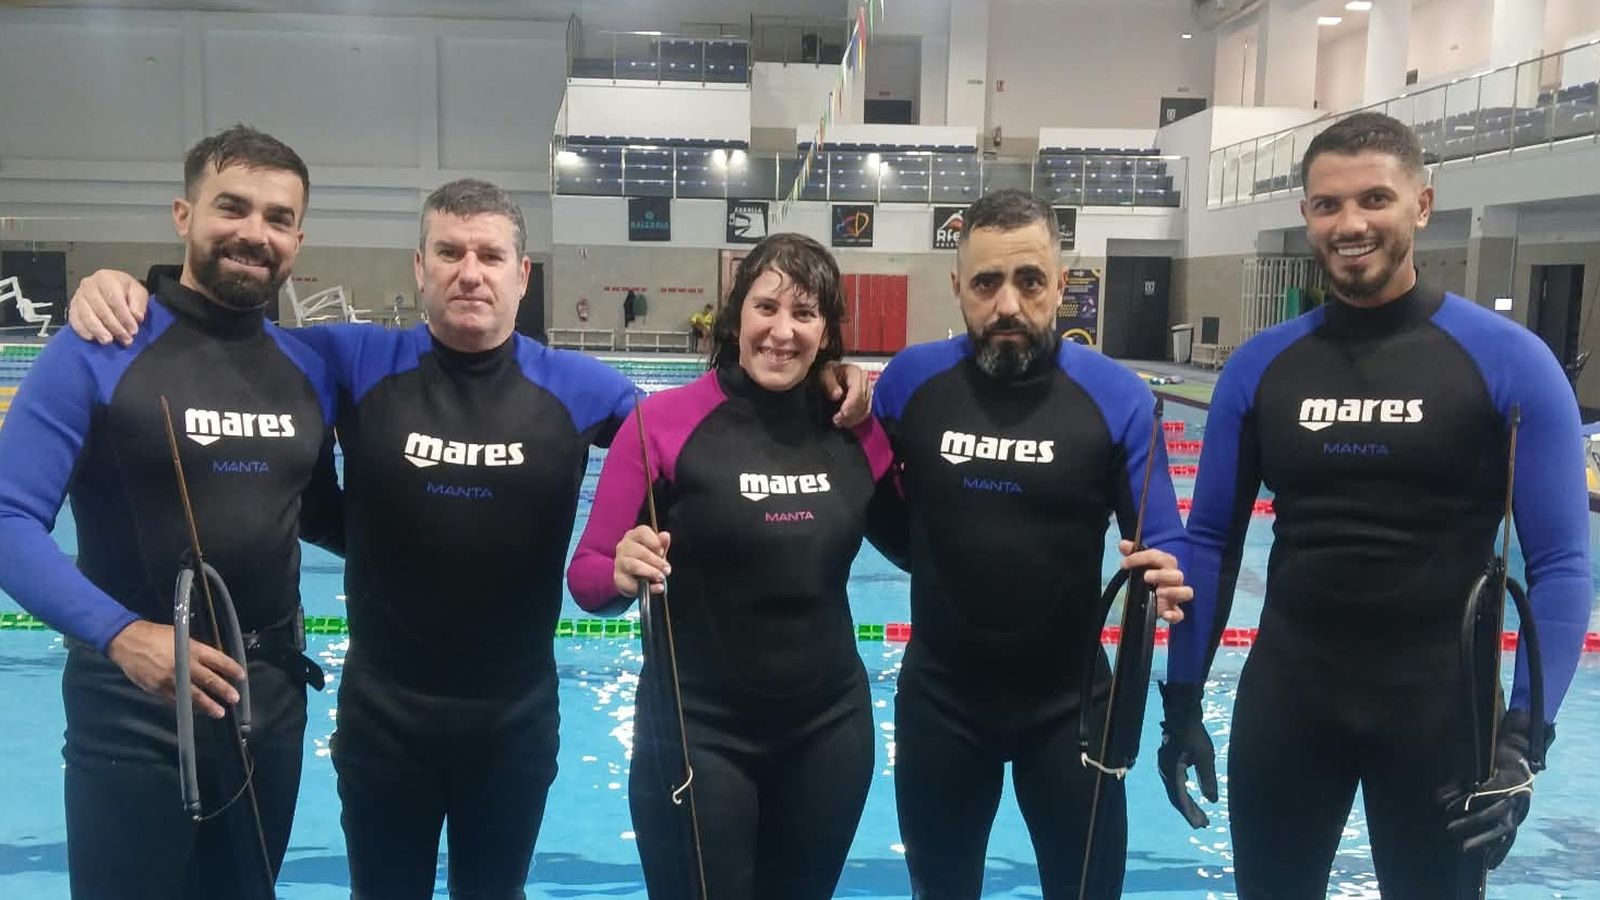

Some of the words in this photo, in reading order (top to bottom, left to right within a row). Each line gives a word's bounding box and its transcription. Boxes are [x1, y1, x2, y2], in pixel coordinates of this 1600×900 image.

[1299, 398, 1424, 423] mares
[184, 408, 296, 438] mares
[404, 432, 525, 467] mares
[940, 430, 1055, 464] mares
[1323, 442, 1389, 456] MANTA
[212, 460, 270, 473] MANTA
[426, 481, 494, 498] MANTA
[739, 472, 831, 494] mares
[961, 476, 1024, 493] MANTA
[764, 510, 815, 522] MANTA
